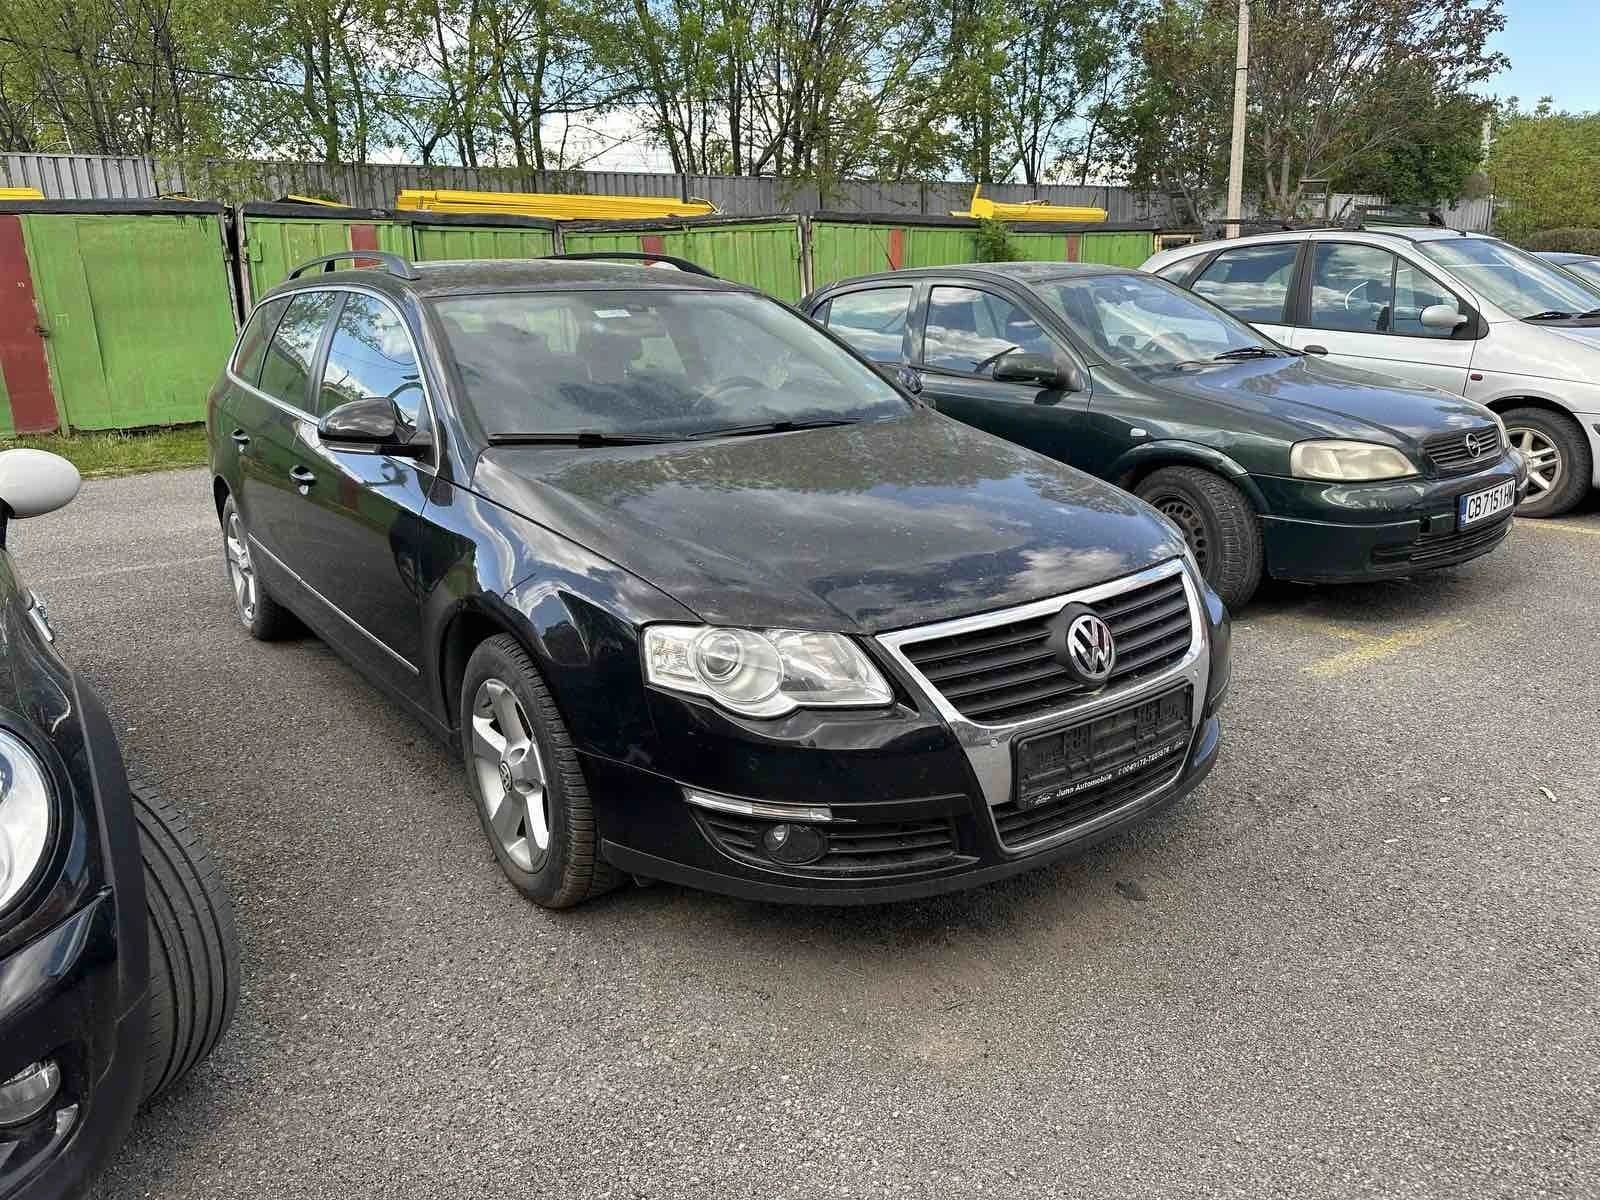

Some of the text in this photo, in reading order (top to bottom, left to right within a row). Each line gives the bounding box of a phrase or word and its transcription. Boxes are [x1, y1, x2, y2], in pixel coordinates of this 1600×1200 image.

[1469, 496, 1482, 519] CB
[1482, 487, 1503, 514] 7151
[1075, 773, 1113, 791] Automobile
